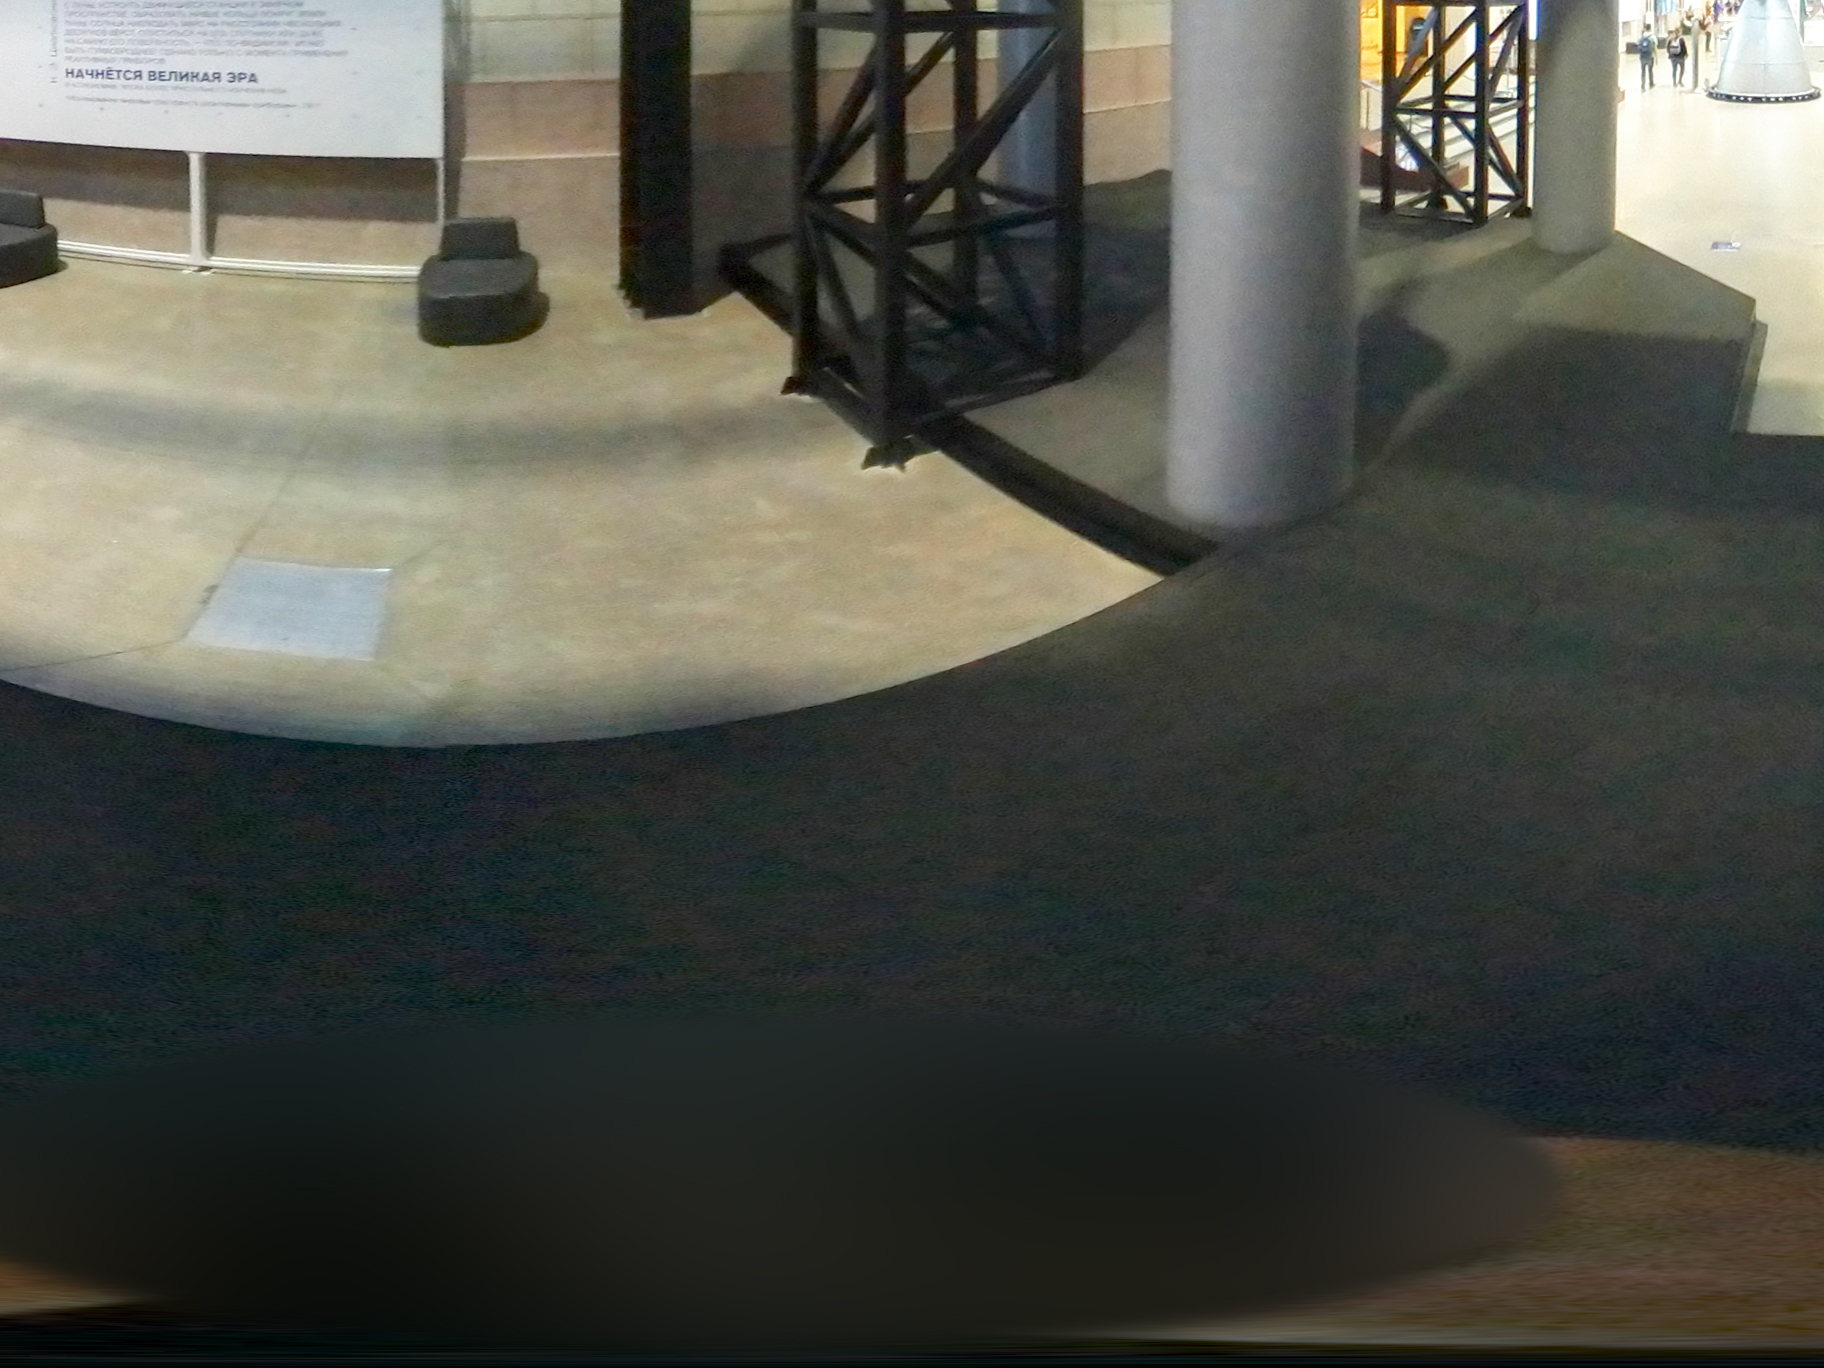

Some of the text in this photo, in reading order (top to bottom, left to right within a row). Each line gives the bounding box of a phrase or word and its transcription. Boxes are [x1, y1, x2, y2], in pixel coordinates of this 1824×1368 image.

[65, 67, 258, 84] НАЧНЁТСЯ ВЕЛИКАЯ ЭРА
